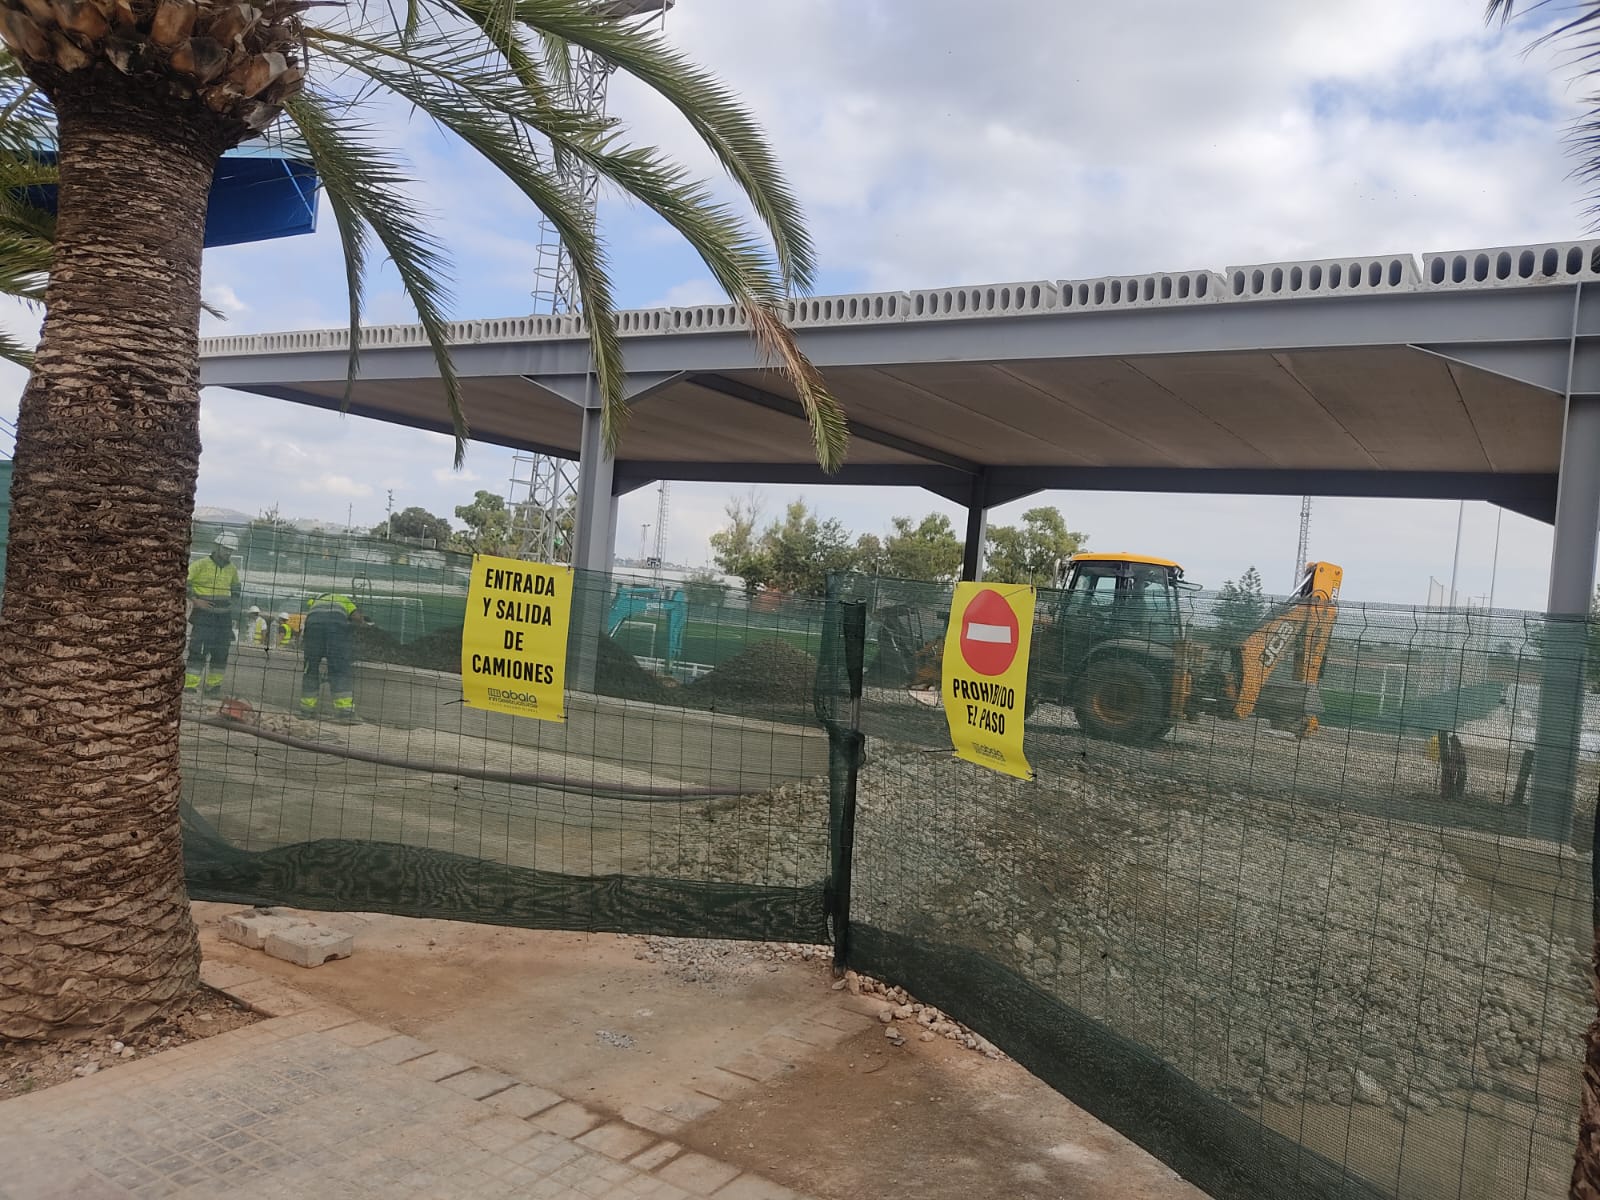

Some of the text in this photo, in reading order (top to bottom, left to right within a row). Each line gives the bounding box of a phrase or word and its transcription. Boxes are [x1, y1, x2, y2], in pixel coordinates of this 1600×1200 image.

[485, 568, 555, 597] ENTRADA
[483, 597, 551, 626] Y SALIDA
[504, 630, 524, 651] DE
[1260, 621, 1296, 668] JCB
[472, 654, 554, 685] CAMIONES
[953, 678, 1014, 710] PROHIBIDO
[967, 704, 1005, 735] EL PASO
